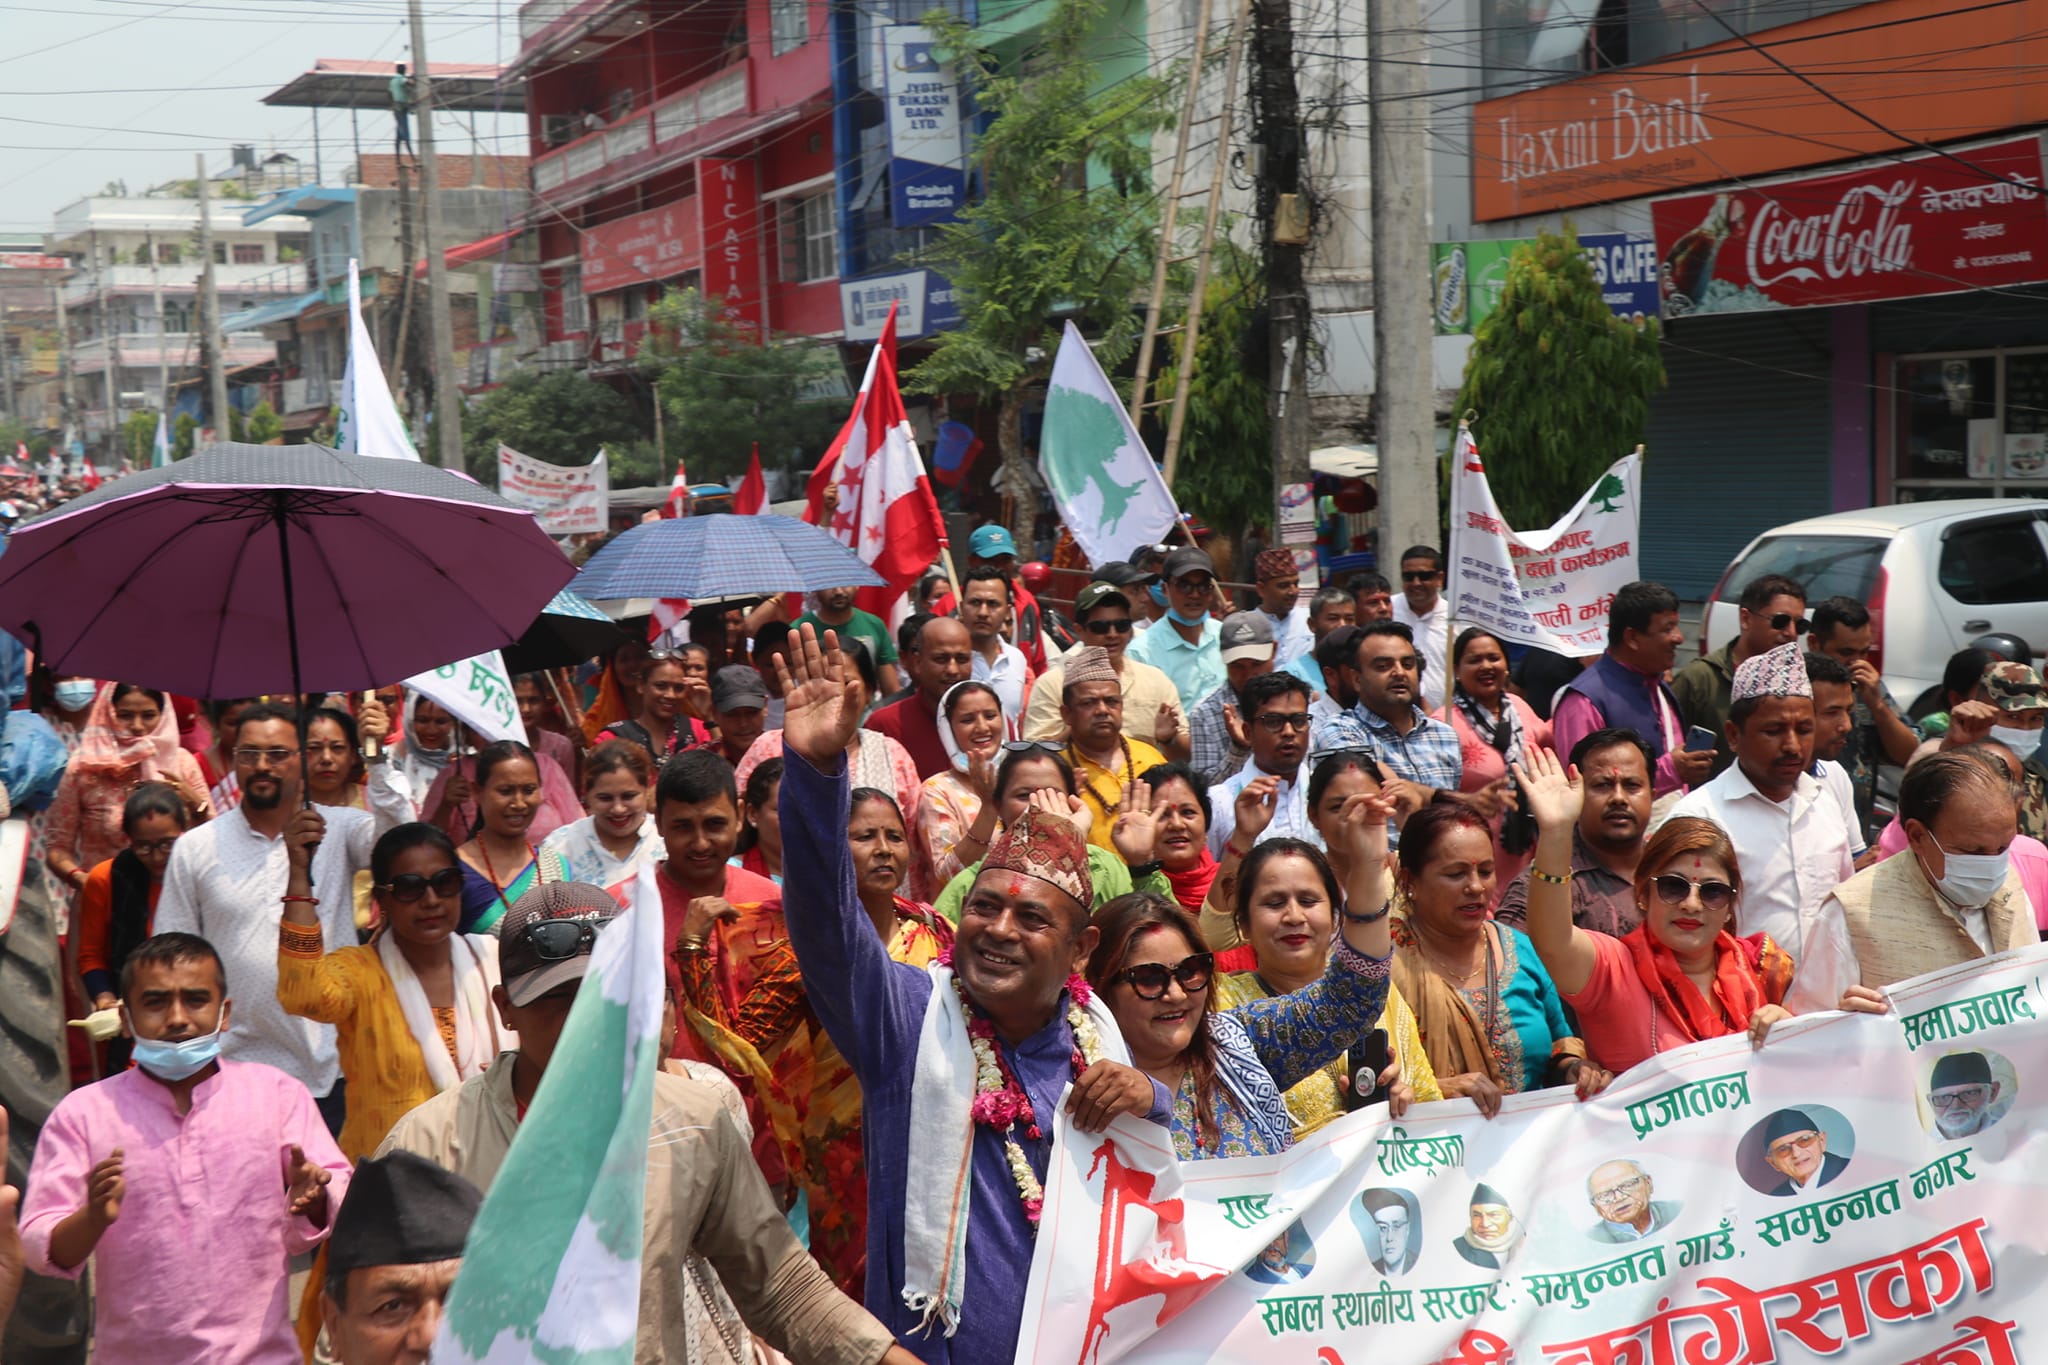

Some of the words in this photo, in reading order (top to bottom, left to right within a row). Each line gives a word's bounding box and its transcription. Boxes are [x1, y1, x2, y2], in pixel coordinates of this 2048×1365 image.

[899, 95, 949, 106] BIKASH
[905, 107, 944, 118] BANK
[912, 119, 939, 129] LTD.
[1499, 97, 1600, 183] Laxmi
[1612, 63, 1713, 160] Bank
[1746, 178, 1918, 287] Coca-Cola
[1611, 243, 1658, 284] CAFE
[1901, 985, 2037, 1051] समाजवाद
[1256, 1295, 1325, 1336] सबल
[1331, 1280, 1416, 1331] स्थानीय
[1522, 1245, 1666, 1309] समुन्नत
[1755, 1179, 1901, 1247] समुन्नत
[1909, 1147, 1976, 1200] नगर
